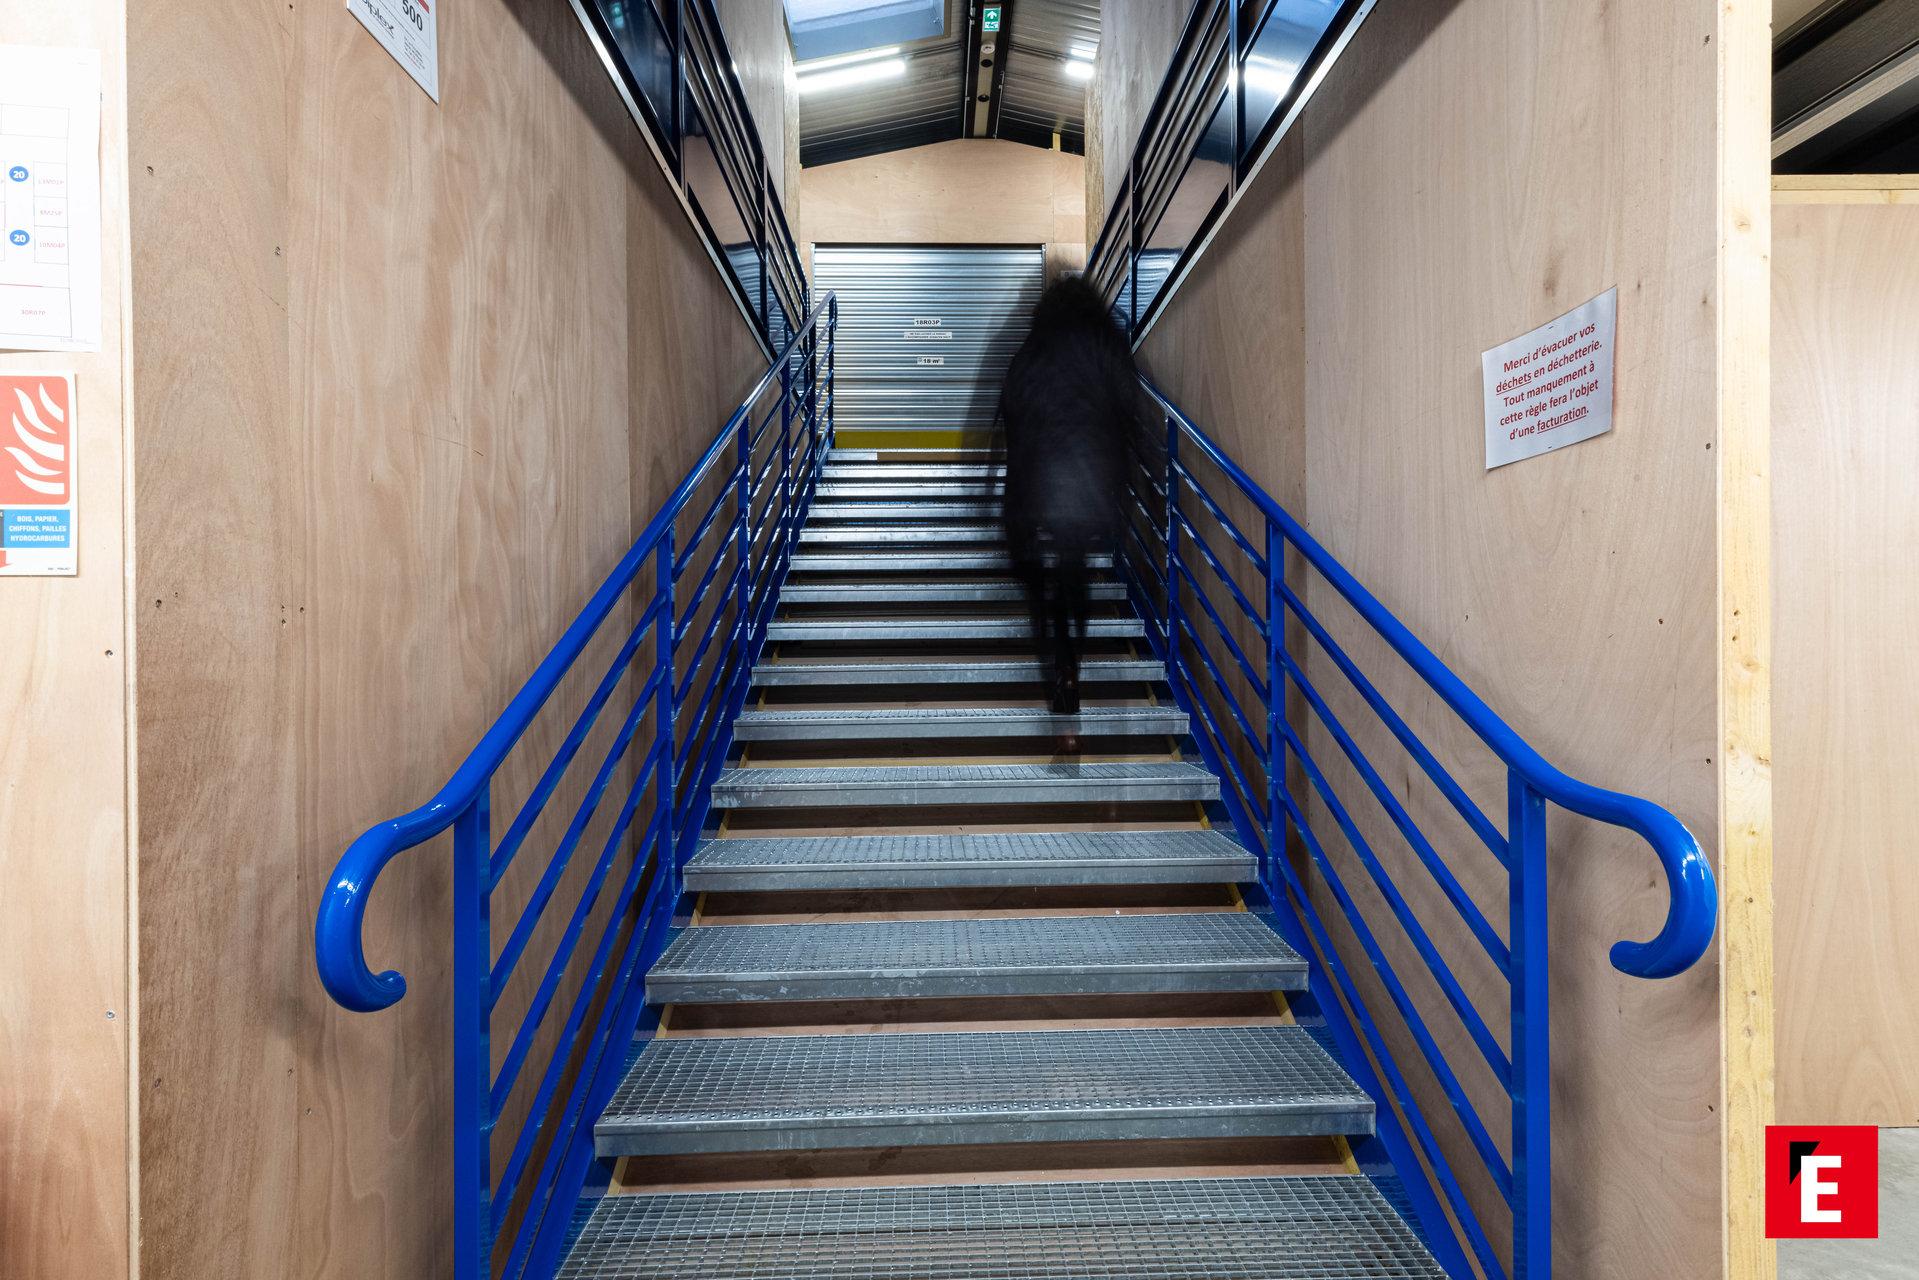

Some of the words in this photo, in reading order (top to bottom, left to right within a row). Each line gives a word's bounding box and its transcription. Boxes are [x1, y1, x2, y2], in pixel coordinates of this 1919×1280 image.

[402, 0, 423, 31] 500
[13, 170, 26, 179] 20
[13, 234, 27, 243] 20
[1496, 372, 1532, 393] déchets
[1533, 367, 1545, 378] en
[1547, 340, 1602, 372] déchetterie.
[1504, 352, 1531, 373] Merci
[1532, 332, 1577, 361] d'évacuer
[1579, 323, 1595, 338] vos
[1500, 411, 1523, 426] cette
[1525, 401, 1548, 417] règle
[1549, 394, 1568, 409] fera
[1569, 379, 1599, 401] l'objet
[1503, 392, 1525, 407] Tout
[1527, 365, 1587, 399] manquement
[1589, 360, 1595, 373] à
[1509, 425, 1535, 441] d'une
[1537, 406, 1589, 432] facturation.
